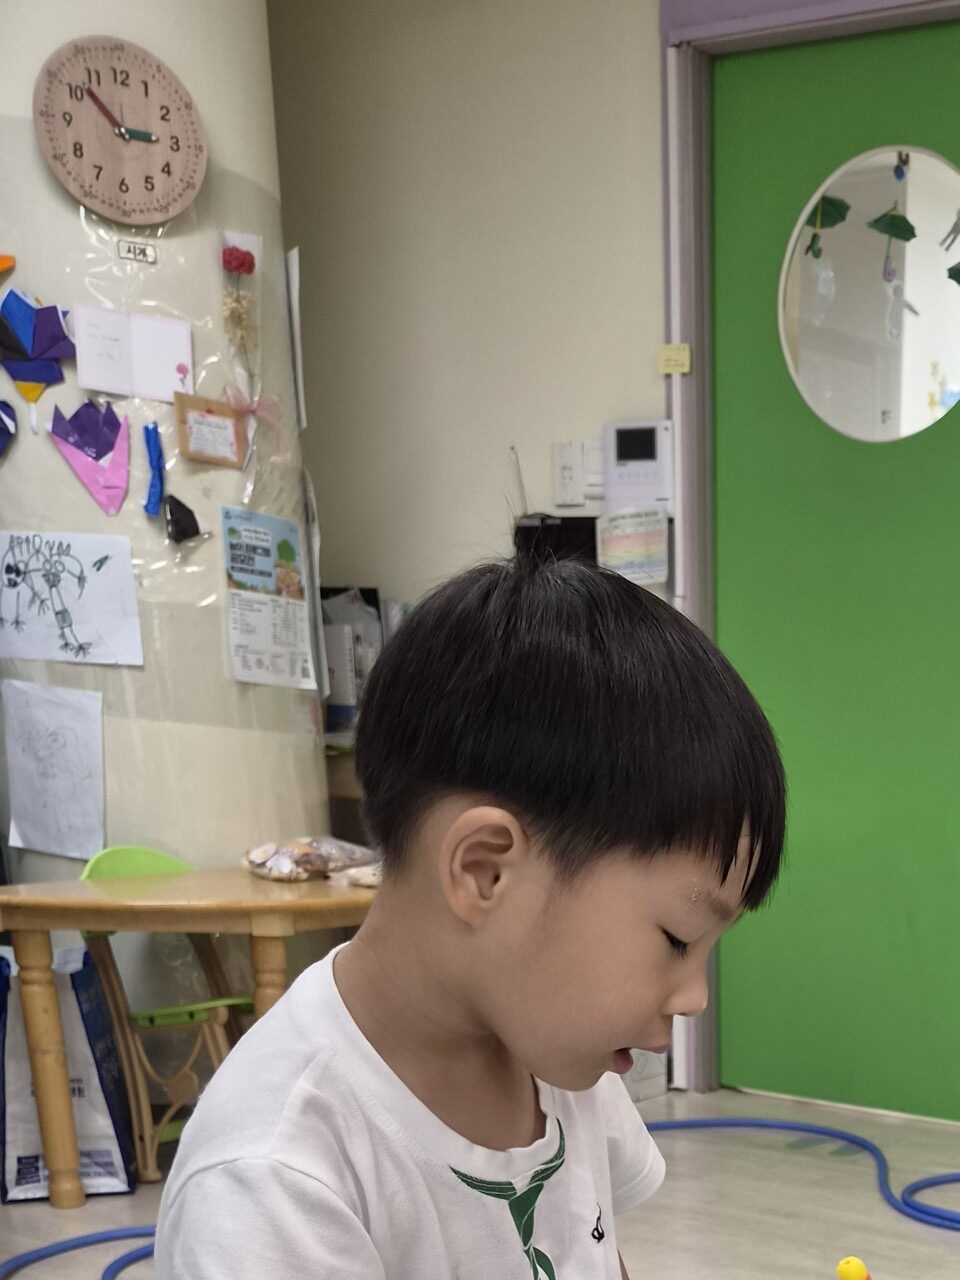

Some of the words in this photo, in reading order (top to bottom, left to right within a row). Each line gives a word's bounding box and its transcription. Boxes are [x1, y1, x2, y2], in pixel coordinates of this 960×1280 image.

[84, 66, 101, 87] 11
[111, 67, 130, 87] 12
[66, 82, 84, 101] 10
[141, 80, 149, 98] 1
[62, 111, 73, 128] 9
[160, 105, 171, 121] 2
[73, 141, 84, 159] 8
[169, 136, 180, 152] 3
[93, 164, 103, 181] 7
[161, 161, 172, 177] 4
[119, 177, 129, 193] 6
[144, 175, 155, 192] 5
